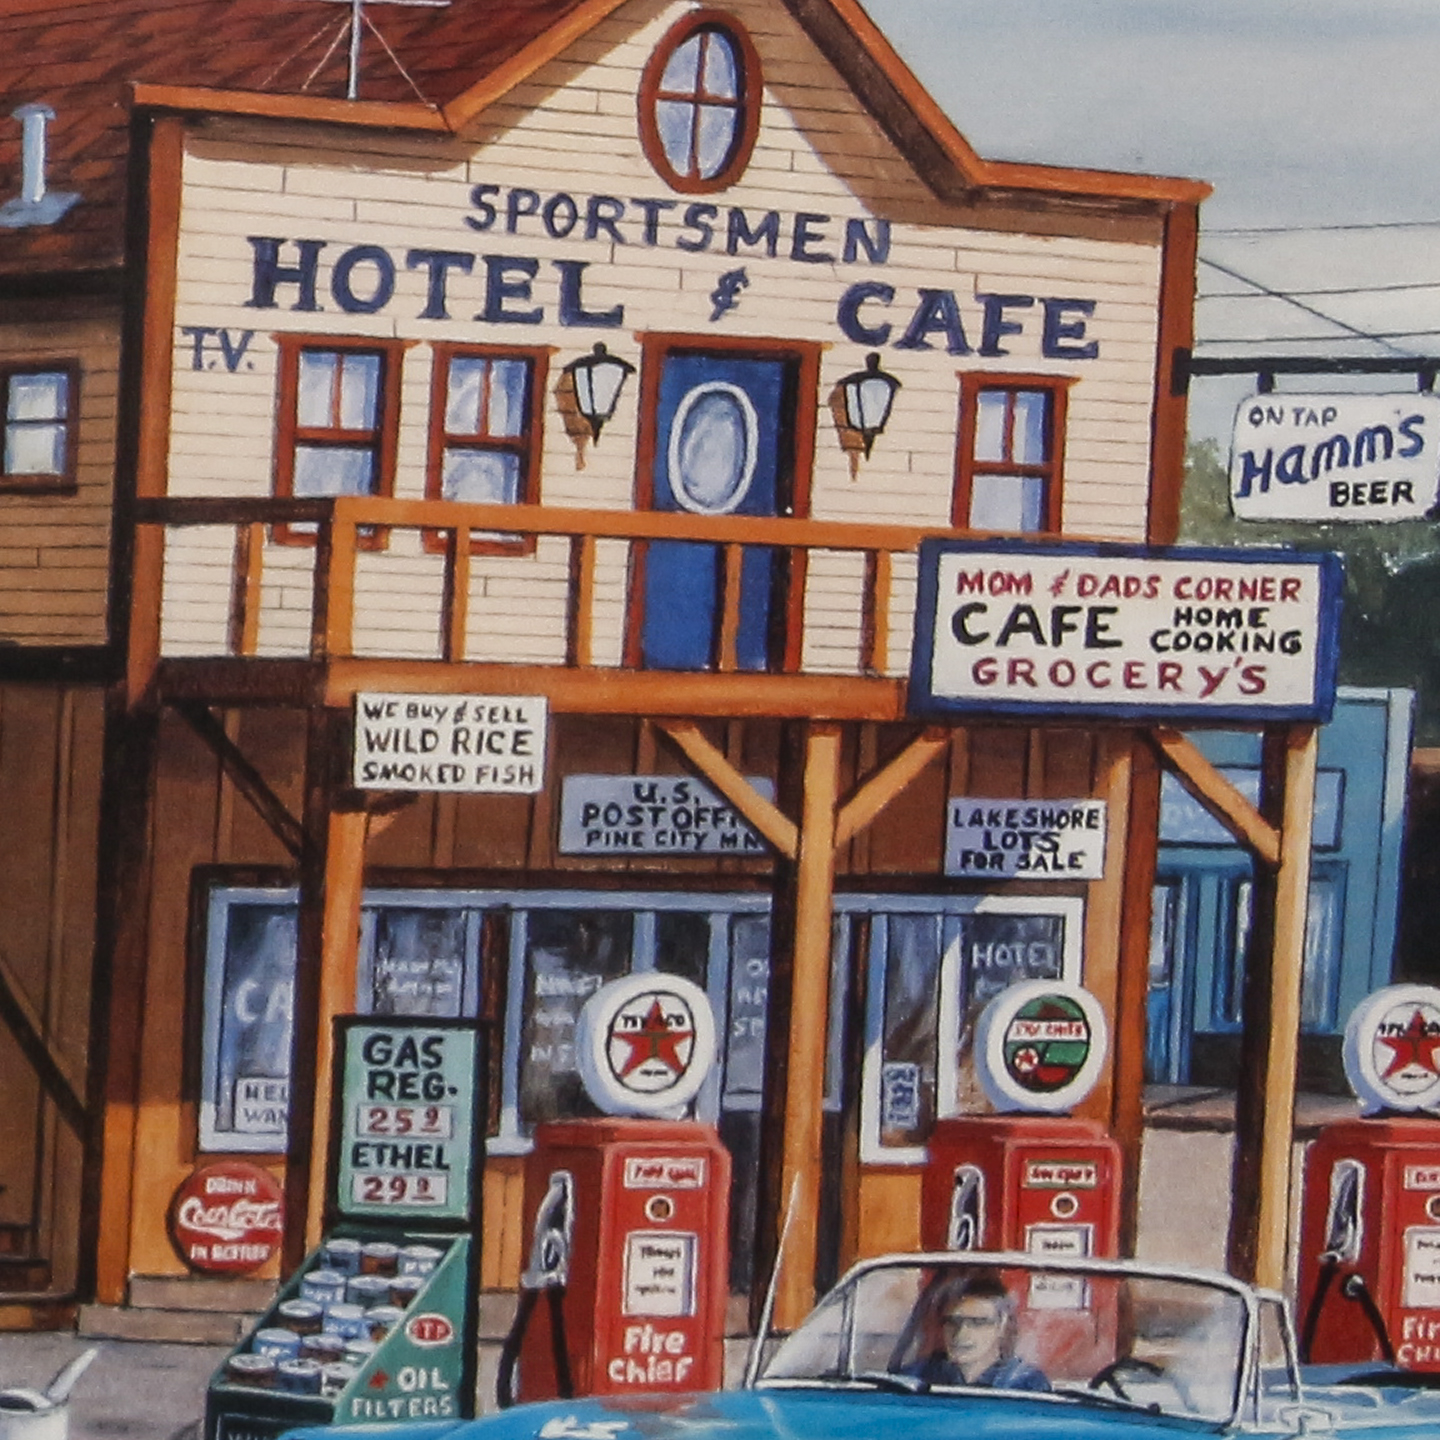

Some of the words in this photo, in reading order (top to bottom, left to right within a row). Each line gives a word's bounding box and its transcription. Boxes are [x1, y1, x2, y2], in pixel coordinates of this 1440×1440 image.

[462, 183, 893, 266] SPORTSMEN
[243, 234, 626, 328] HOTEL
[836, 281, 1100, 361] CAFE
[1248, 406, 1284, 428] ON
[1292, 407, 1337, 425] TAP
[1329, 480, 1416, 507] BEER
[956, 570, 1033, 596] MOM
[1077, 572, 1160, 599] DADS
[1174, 576, 1302, 601] CORNER
[950, 601, 1123, 649] CAFE
[1174, 606, 1270, 629] HOME
[1150, 628, 1302, 655] COOKING
[972, 656, 1268, 699] GROCERY'S
[364, 701, 398, 721] WE
[406, 702, 448, 725] BUY
[473, 704, 528, 724] SELL
[364, 727, 439, 755] WILD
[451, 727, 534, 756] RICE
[362, 762, 465, 783] SMOKED
[475, 765, 534, 786] FISH
[581, 803, 666, 828] POST
[671, 803, 737, 830] OFFI
[586, 831, 644, 848] PINE
[654, 831, 709, 850] CITY
[982, 830, 1061, 853] LOTS
[960, 849, 1006, 872] FOR
[1015, 850, 1087, 872] SALE
[235, 978, 294, 1023] CA
[362, 1034, 445, 1070] GAS
[367, 1070, 458, 1101] REG.
[351, 1142, 450, 1171] ETHEL
[623, 1323, 686, 1355] Fire
[397, 1366, 449, 1392] OIL
[351, 1396, 455, 1418] FILTERS
